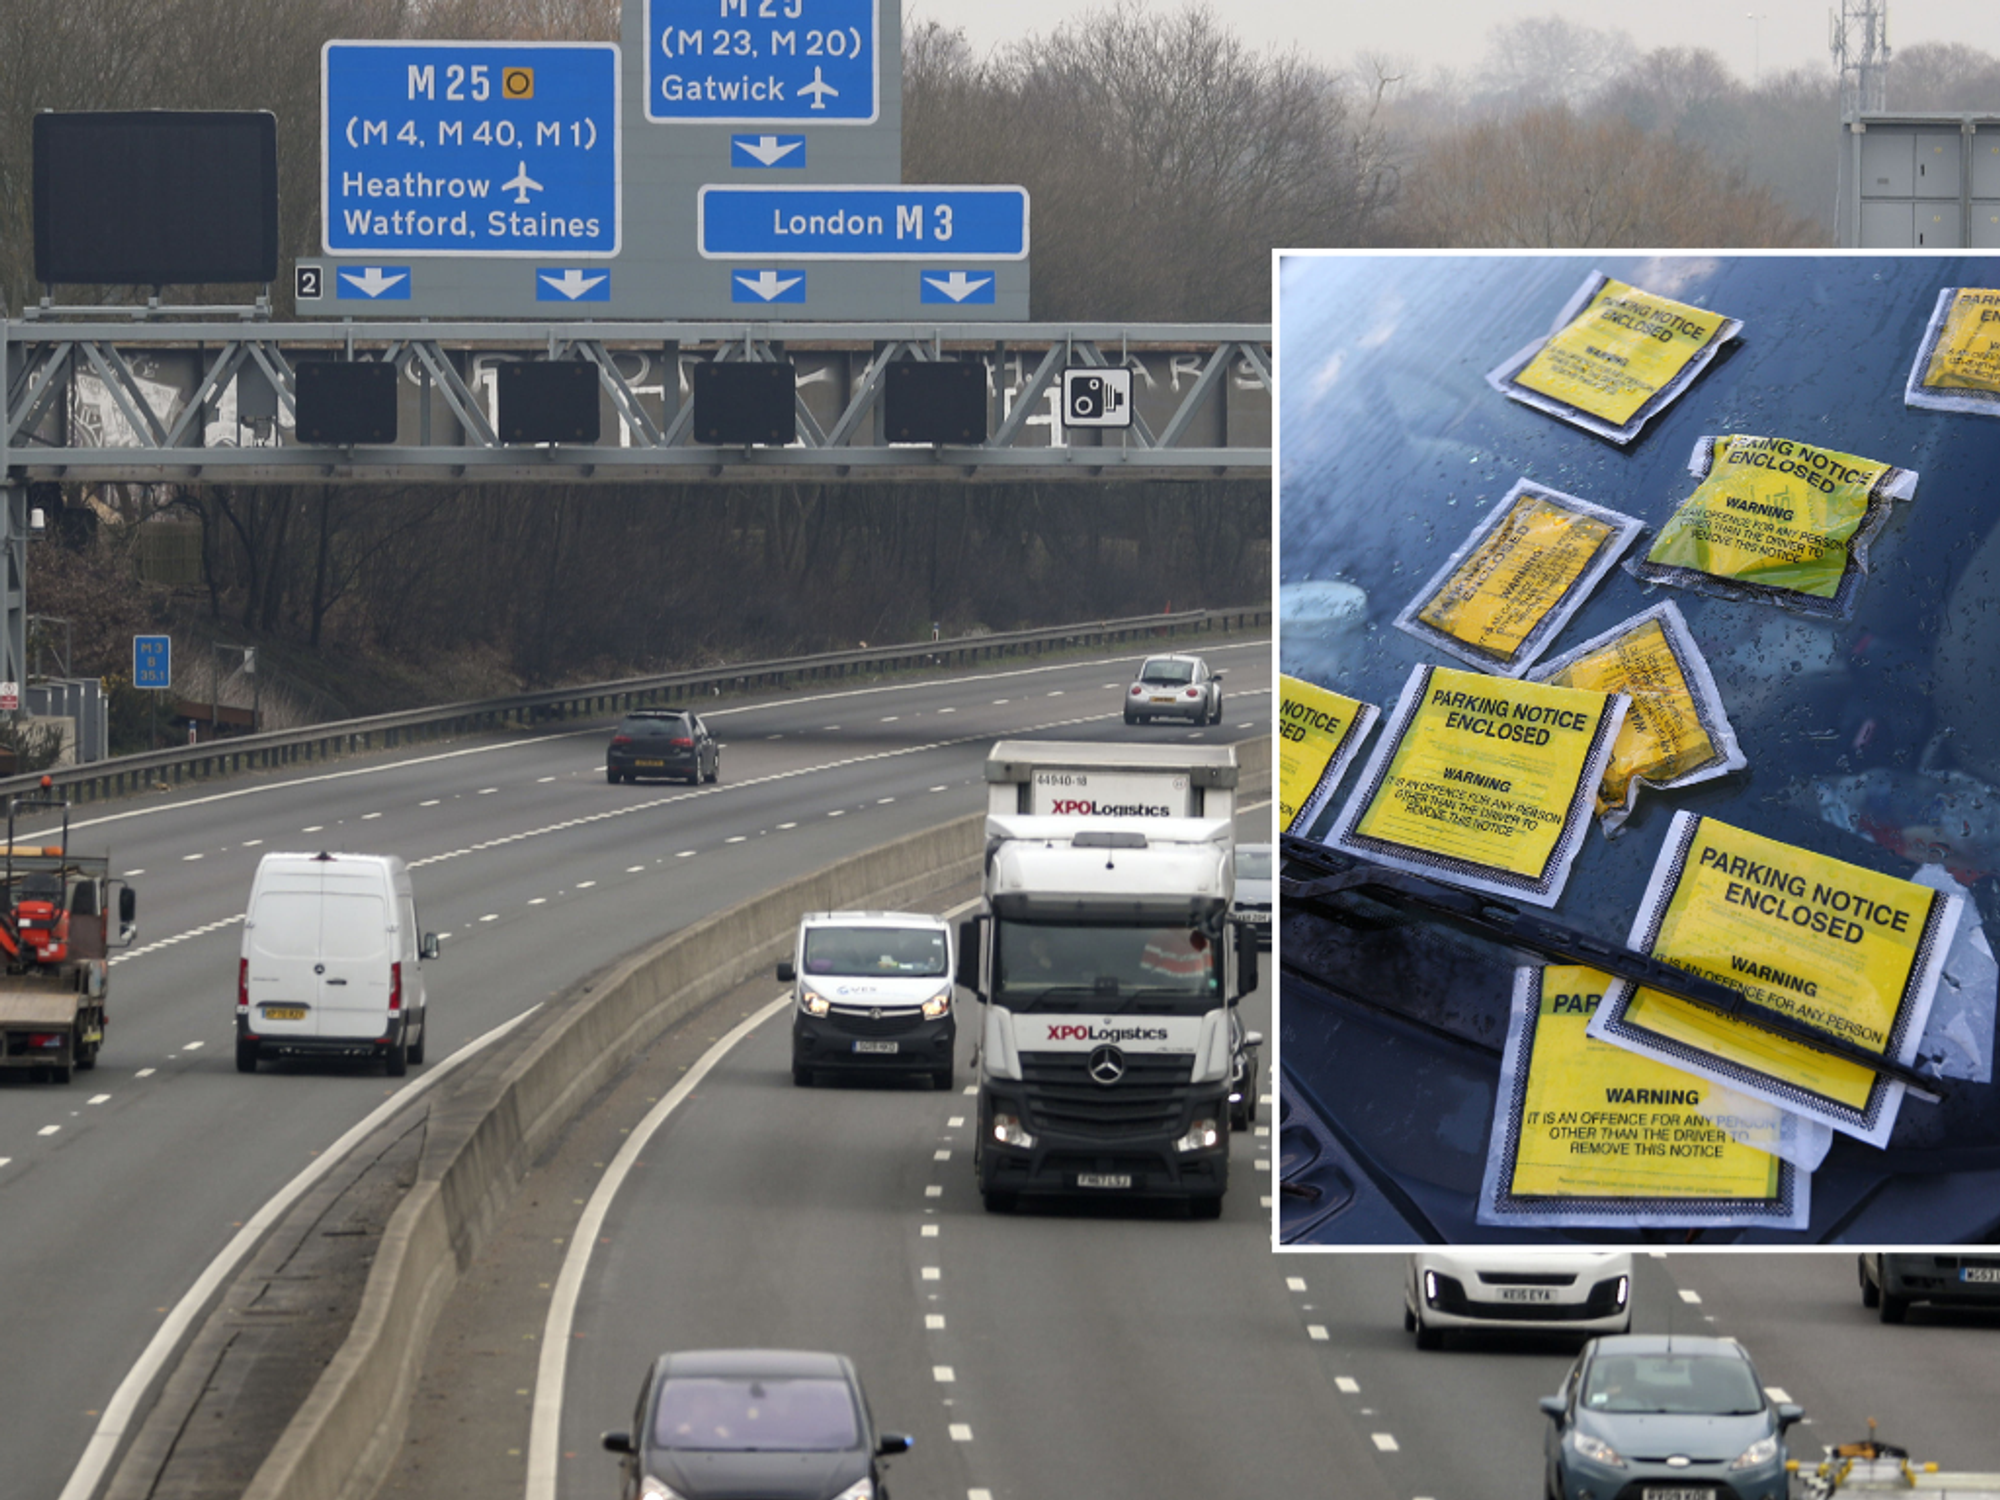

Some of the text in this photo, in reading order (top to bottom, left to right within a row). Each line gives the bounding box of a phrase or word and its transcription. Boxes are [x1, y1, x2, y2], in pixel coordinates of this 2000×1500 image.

[661, 74, 785, 101] Gatwick
[342, 171, 490, 198] Heathrow
[343, 209, 600, 239] Watford, Staines
[774, 209, 883, 235] London
[302, 272, 316, 293] 2
[1600, 309, 1674, 343] ENCLOSED
[1650, 309, 1706, 341] NOTICE
[1728, 451, 1836, 494] ENCLOSED
[1798, 448, 1874, 486] NOTICE
[1726, 496, 1794, 521] WARNING
[1759, 545, 1802, 564] NOTICE
[1808, 546, 1824, 559] TO
[1281, 699, 1341, 734] NOTICE
[1432, 689, 1588, 732] PARKING NOTICE
[1446, 712, 1550, 746] ENCLOSED
[1443, 767, 1512, 793] WARNING
[1405, 779, 1420, 791] AN
[1420, 782, 1468, 801] OFFENCE
[1492, 798, 1515, 812] ANY
[1515, 804, 1562, 825] PERSON
[1430, 794, 1456, 809] THAN
[1458, 801, 1479, 816] THE
[1479, 807, 1520, 826] DRIVER
[1521, 818, 1538, 832] TO
[1475, 818, 1516, 837] NOTICE
[1700, 846, 1910, 933] PARKING NOTICE
[1725, 882, 1864, 944] ENCLOSED
[1731, 955, 1818, 998] WARNING
[1705, 970, 1767, 1001] OFFENCE
[1767, 992, 1796, 1011] FOR
[1796, 1003, 1826, 1023] ANY
[1827, 1011, 1884, 1045] PERSON
[1606, 1088, 1699, 1106] WARNING
[1527, 1112, 1539, 1125] IT
[1543, 1112, 1556, 1125] IS
[1557, 1112, 1579, 1125] AN
[1580, 1112, 1648, 1127] OFFENCE
[1650, 1114, 1681, 1127] FOR
[1683, 1115, 1713, 1128] ANY
[1549, 1127, 1597, 1140] OTHER
[1601, 1127, 1638, 1141] THAN
[1642, 1128, 1670, 1142] THE
[1674, 1129, 1727, 1143] DRIVER
[1570, 1142, 1724, 1158] REMOVE THIS NOTICE
